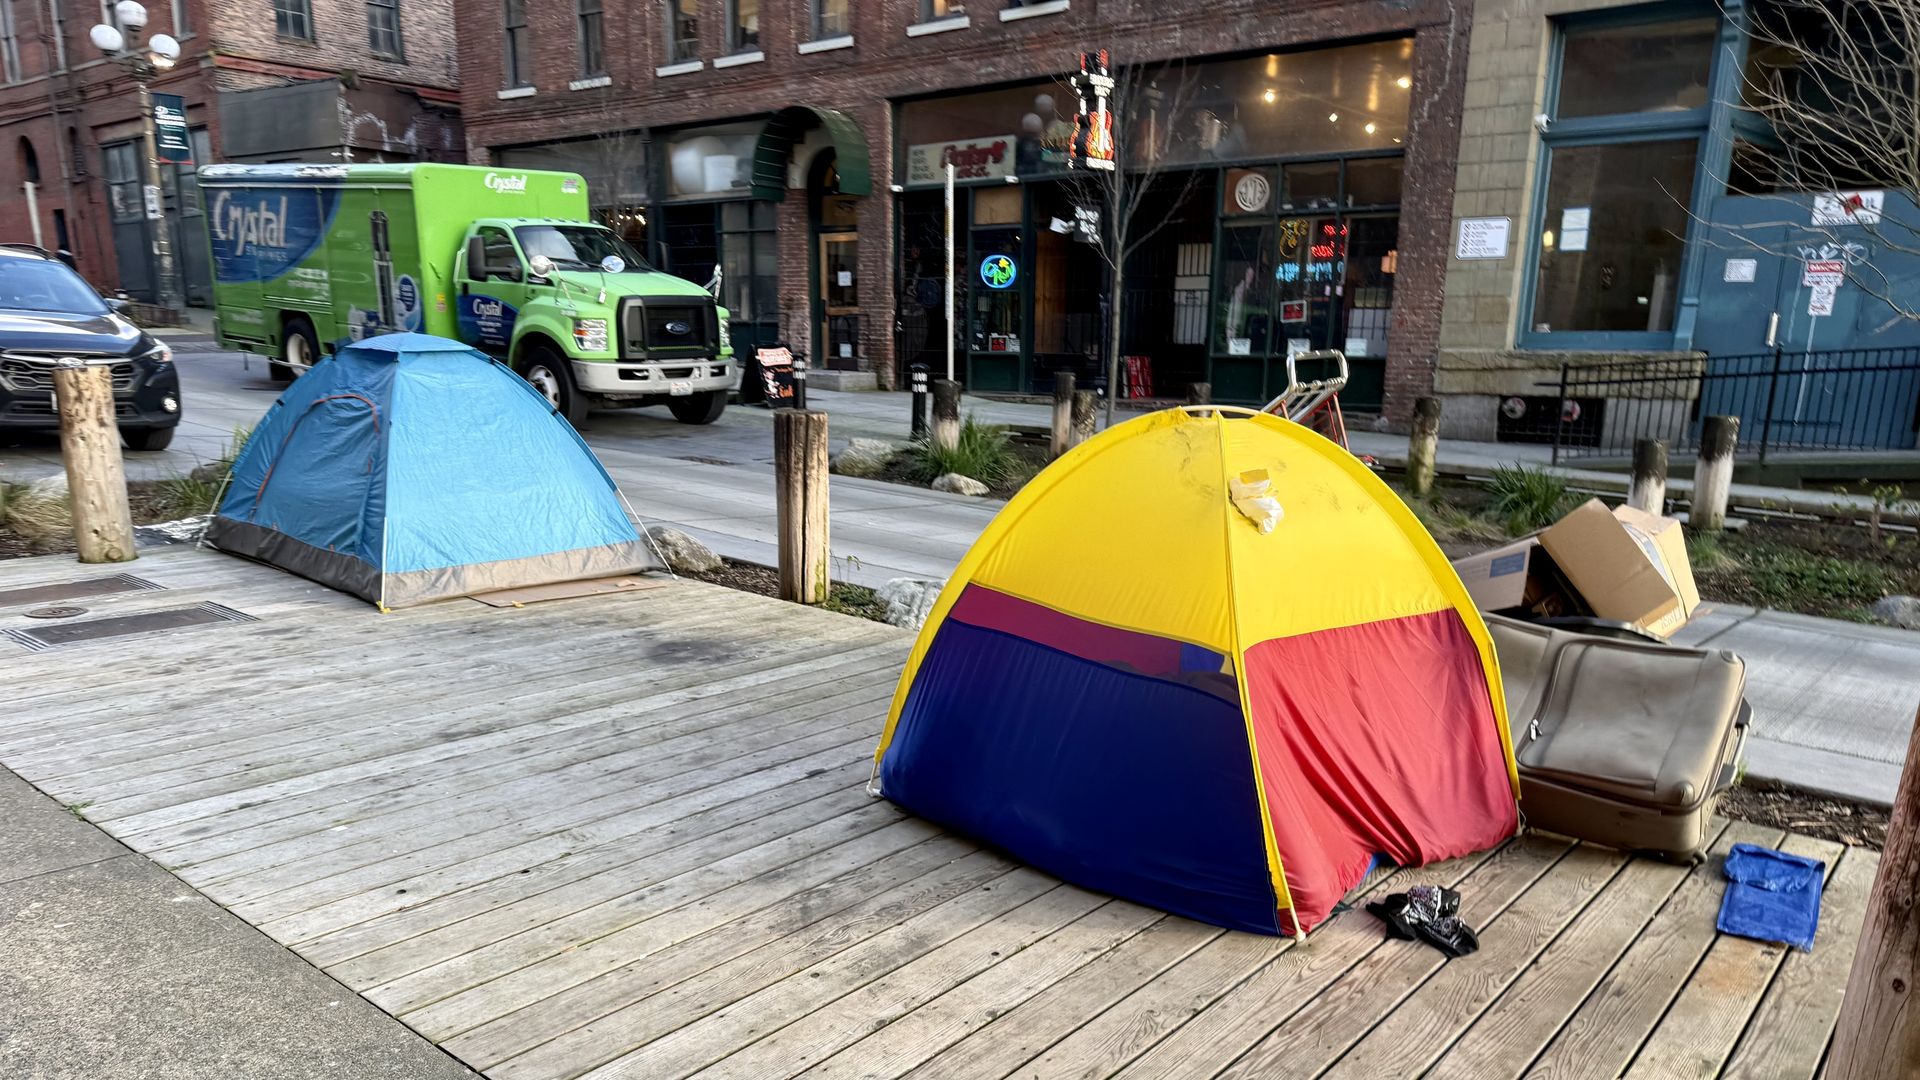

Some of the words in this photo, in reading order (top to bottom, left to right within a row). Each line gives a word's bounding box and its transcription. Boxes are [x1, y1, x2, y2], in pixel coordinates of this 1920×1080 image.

[484, 172, 527, 194] Crystal
[213, 190, 288, 257] Crystal
[472, 298, 503, 320] Crystal
